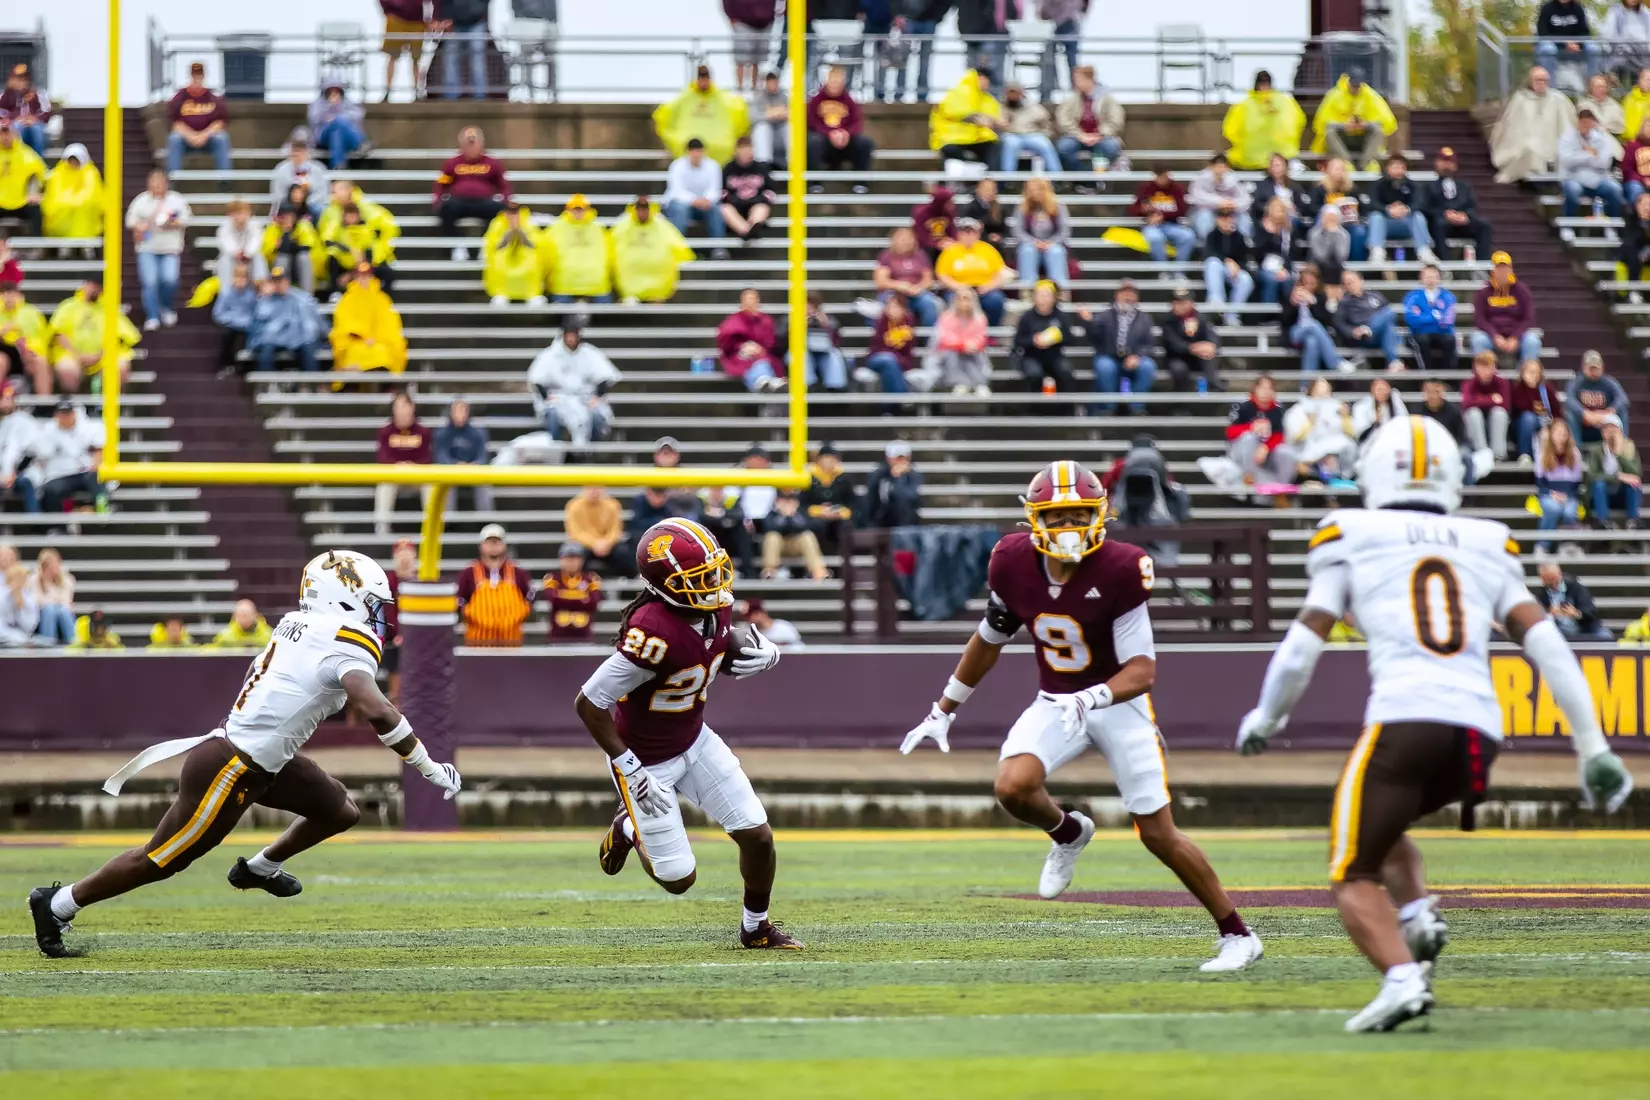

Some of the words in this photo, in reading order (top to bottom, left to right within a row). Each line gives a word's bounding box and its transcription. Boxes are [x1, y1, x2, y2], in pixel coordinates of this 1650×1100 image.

[1138, 555, 1155, 590] 9
[1409, 554, 1466, 659] 0
[621, 627, 668, 665] 20
[1034, 612, 1092, 672] 9
[1490, 655, 1650, 736] RAM
